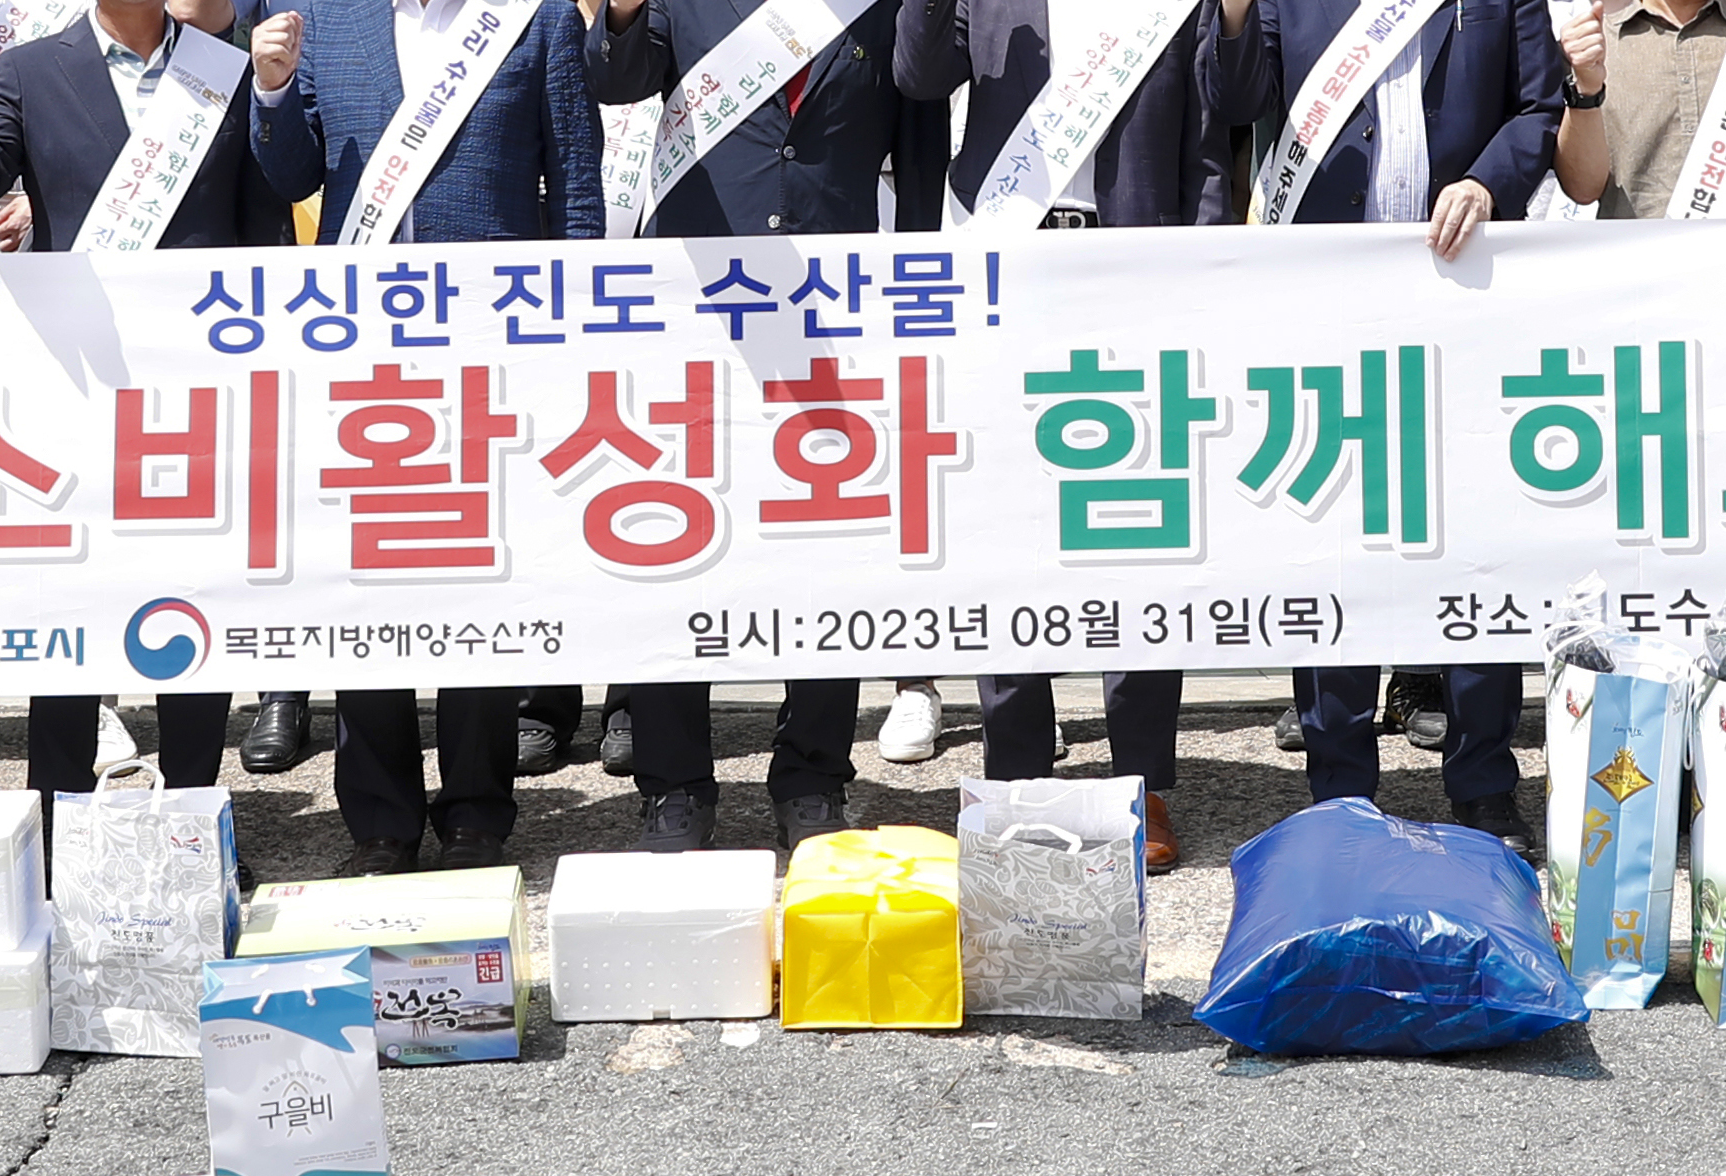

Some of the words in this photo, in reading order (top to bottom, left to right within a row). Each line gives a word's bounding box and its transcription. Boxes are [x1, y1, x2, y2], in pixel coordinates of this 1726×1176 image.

[461, 10, 501, 57] 우리
[1136, 10, 1171, 48] 우리
[738, 60, 778, 101] 우리
[1056, 31, 1120, 108] 영양가득
[1104, 46, 1144, 89] 함께
[1321, 42, 1372, 103] 소비에
[177, 111, 209, 152] 우리
[400, 60, 468, 151] 수산물은
[698, 94, 741, 136] 함께
[1021, 108, 1065, 153] 진도
[1046, 89, 1114, 169] 소비해요
[1286, 99, 1332, 168] 동참해
[104, 136, 164, 223] 영양가득
[153, 149, 191, 196] 함께
[984, 152, 1033, 218] 수산물
[191, 262, 460, 356] 싱싱한
[489, 255, 668, 350] 진도
[693, 247, 1004, 341] 수산물!
[1023, 344, 1429, 552] 함께
[224, 619, 565, 661] 목포지방해양수산청
[1008, 598, 1123, 654] 08월
[1141, 592, 1347, 652] 31일(목)
